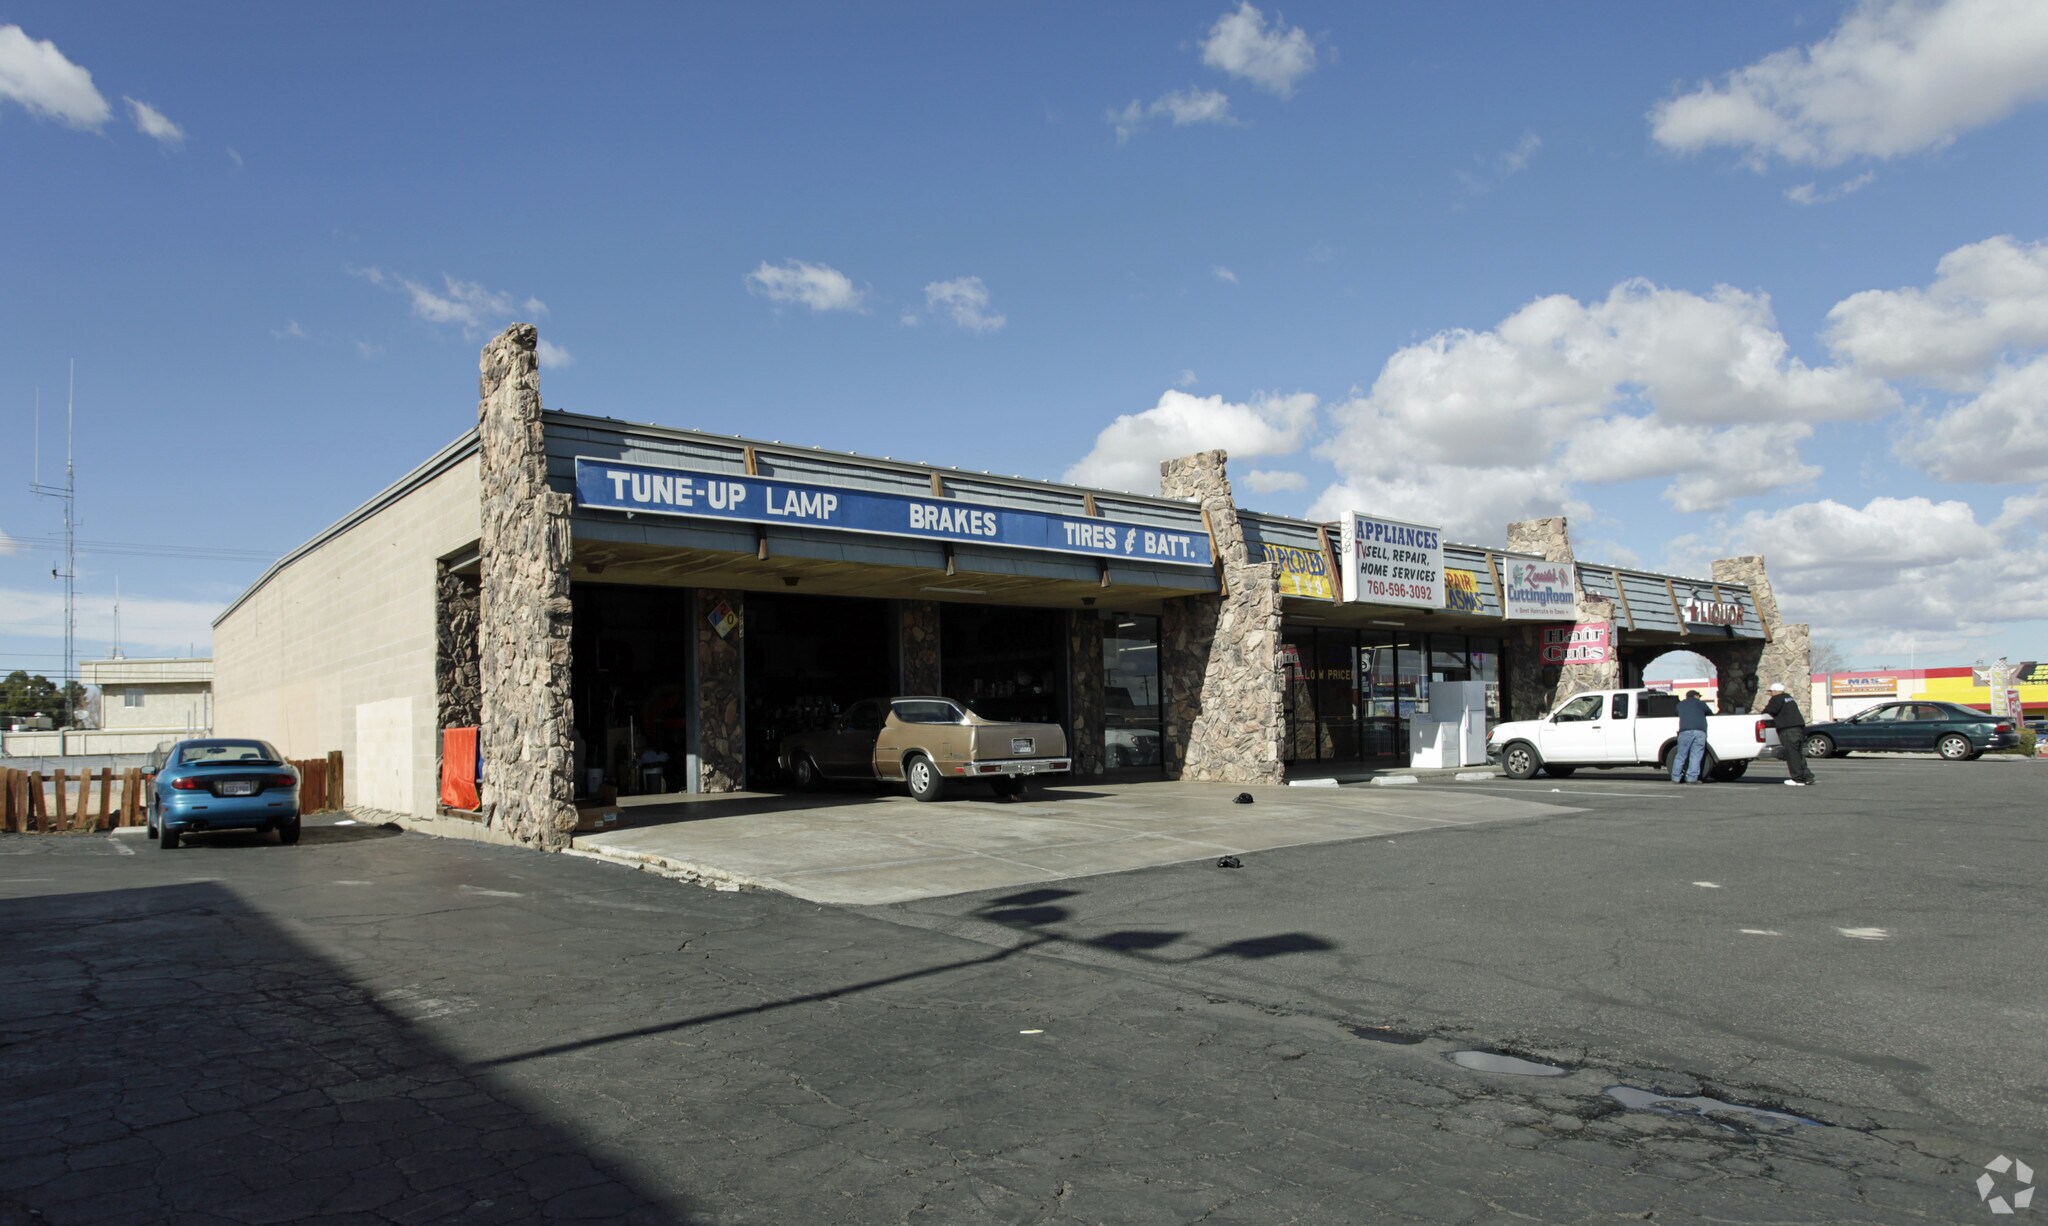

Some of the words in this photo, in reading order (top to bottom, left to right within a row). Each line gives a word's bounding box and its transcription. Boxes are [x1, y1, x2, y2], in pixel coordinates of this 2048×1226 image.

[606, 470, 747, 511] TUNE-UP
[766, 487, 838, 520] LAMP
[909, 503, 997, 537] BRAKES
[1063, 521, 1117, 550] TIRES
[1144, 532, 1196, 559] BATT.
[1356, 520, 1438, 550] APPLIANCES
[1366, 545, 1390, 561] SELL,
[1392, 549, 1430, 566] REPAIR,
[1360, 562, 1389, 577] HOME
[1392, 567, 1436, 583] SERVICES
[727, 613, 734, 625] 0
[1700, 602, 1744, 626] LIQUOR
[1544, 626, 1604, 645] Hair
[1543, 645, 1604, 662] Cuts
